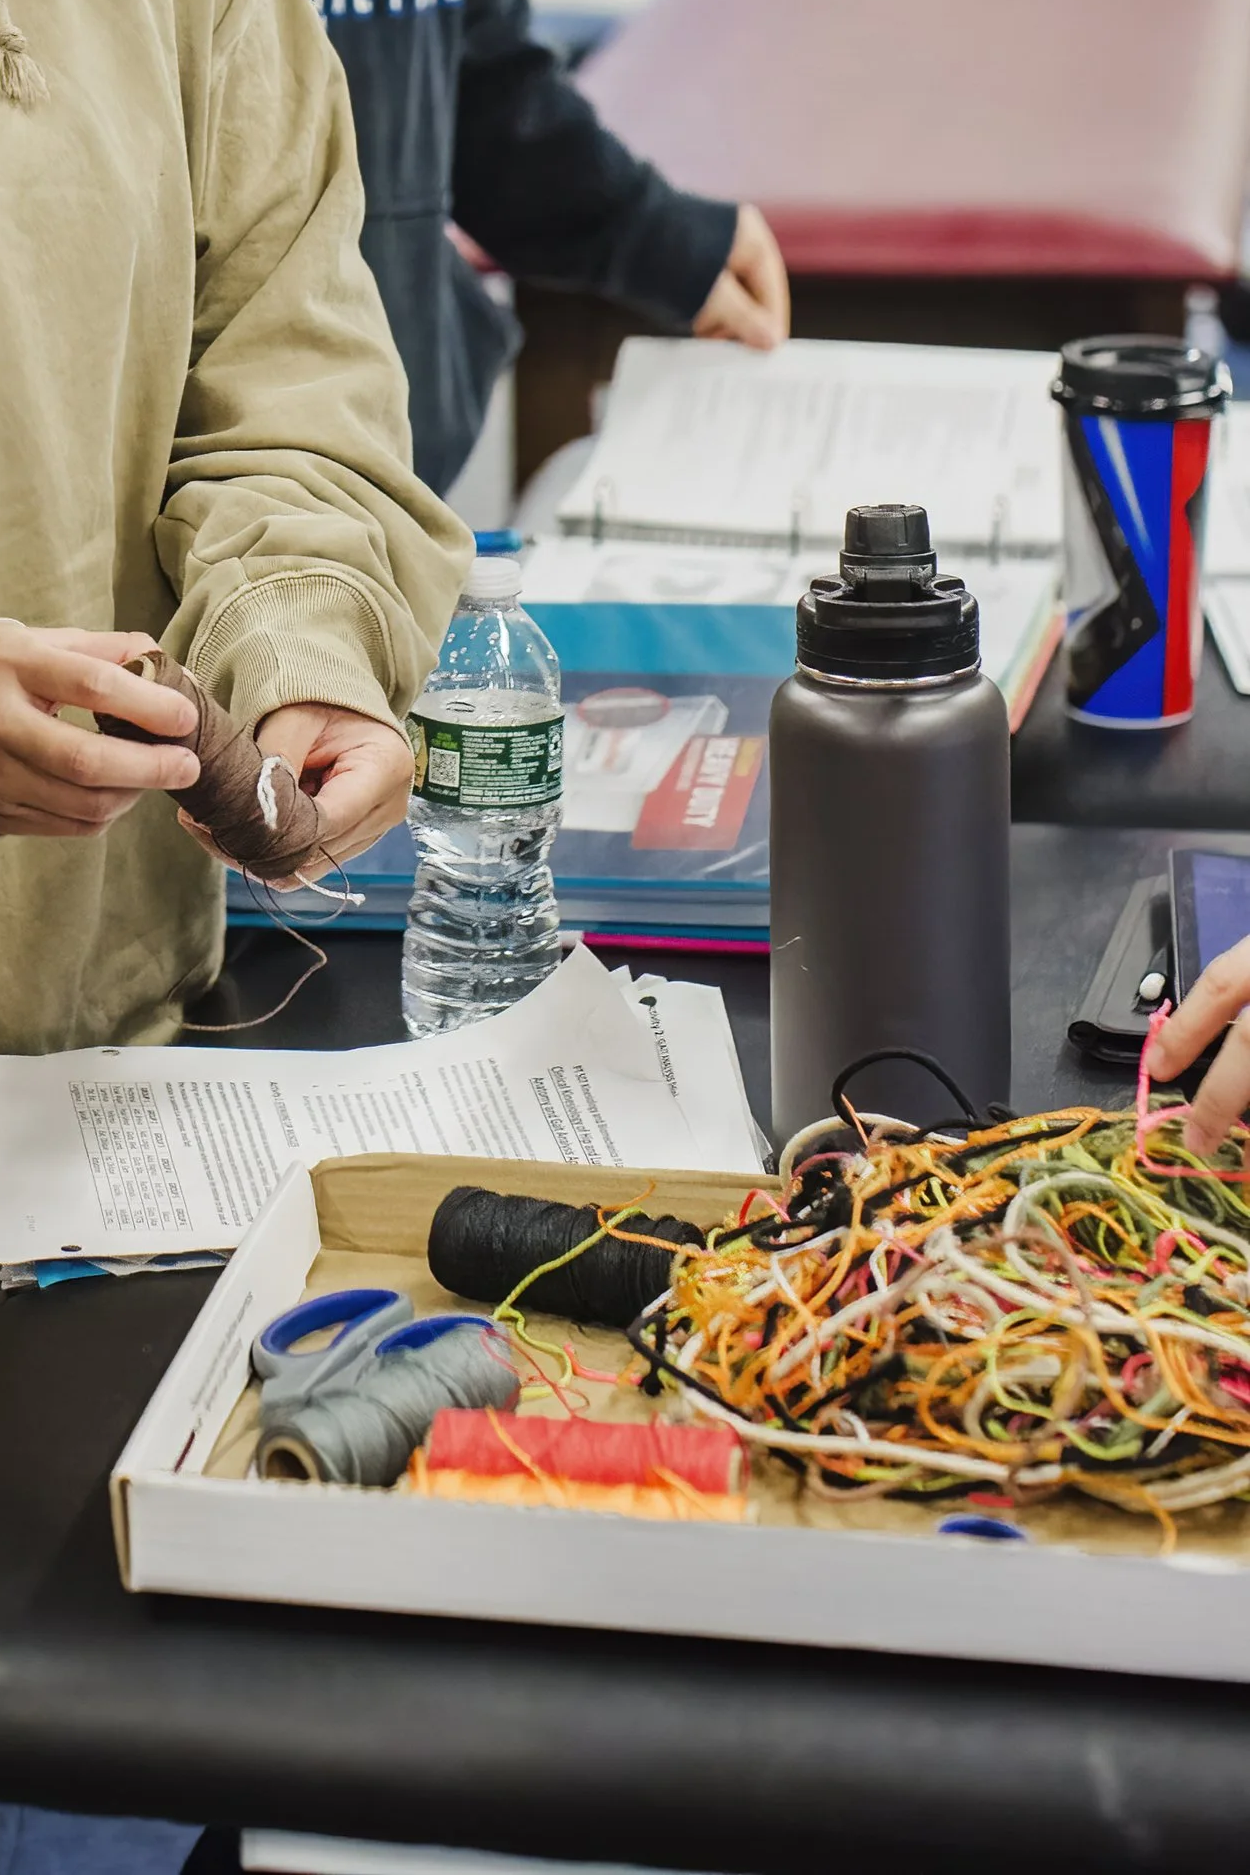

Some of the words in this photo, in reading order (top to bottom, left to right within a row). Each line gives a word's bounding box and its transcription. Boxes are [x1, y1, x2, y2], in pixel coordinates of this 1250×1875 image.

[551, 1066, 570, 1090] Clinical
[532, 1078, 551, 1106] Anatomy
[545, 1106, 559, 1118] and
[562, 1089, 583, 1125] Kinesiology
[550, 1118, 563, 1131] Gait
[556, 1132, 574, 1156] Analysis
[582, 1133, 593, 1144] Hip
[585, 1144, 600, 1156] and
